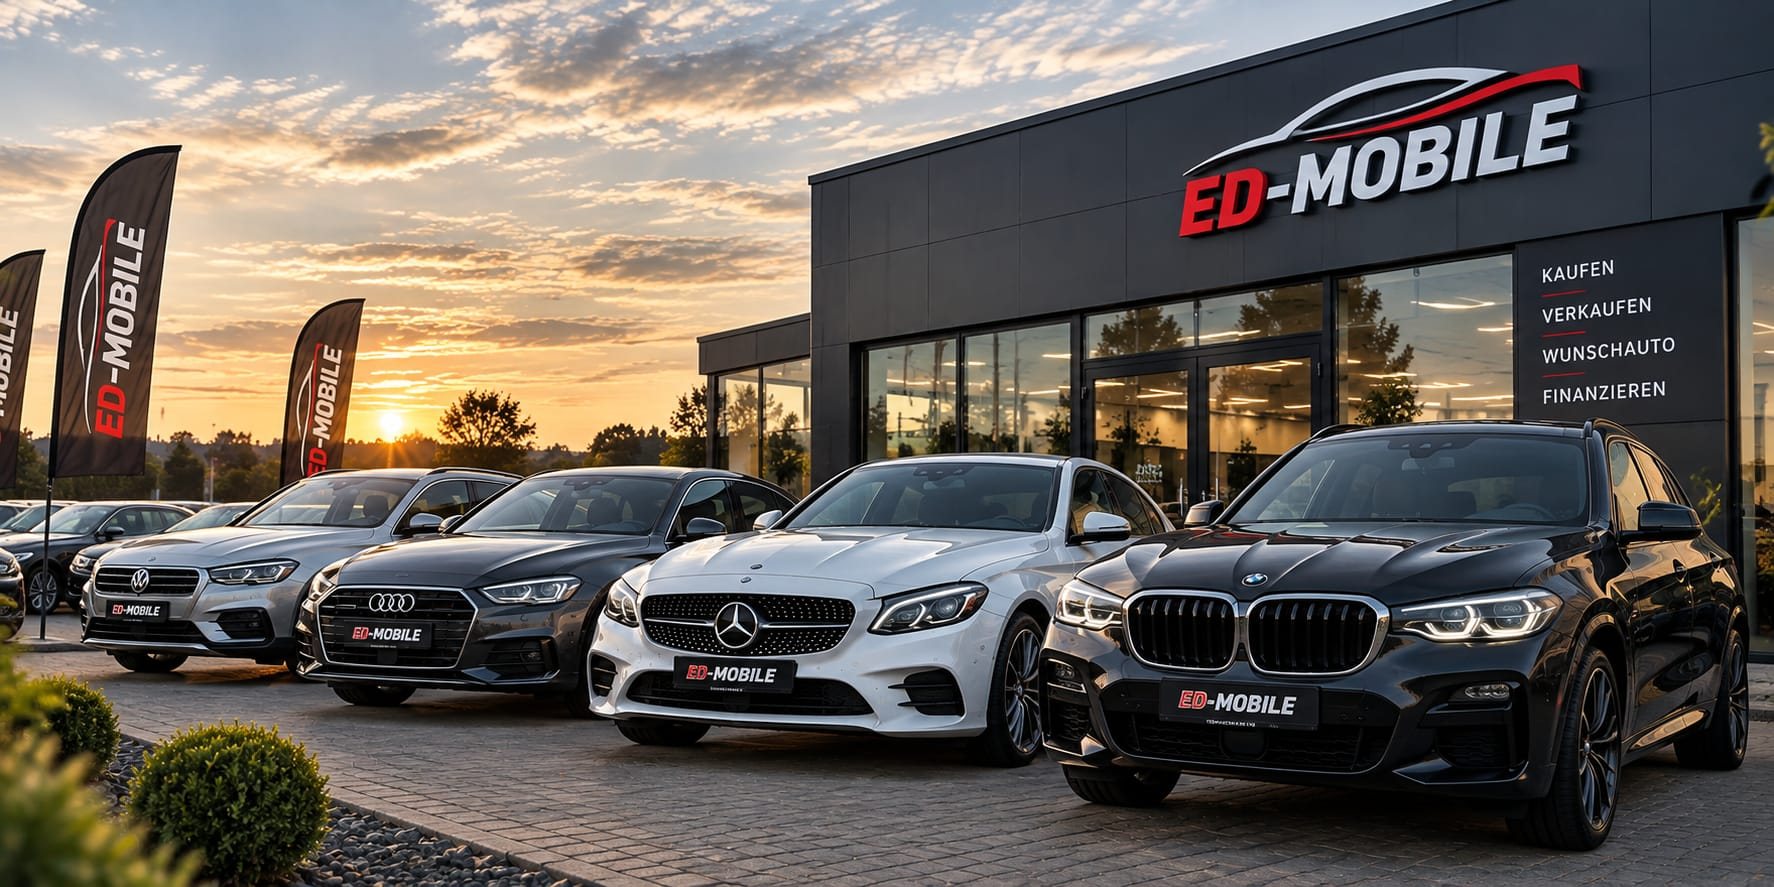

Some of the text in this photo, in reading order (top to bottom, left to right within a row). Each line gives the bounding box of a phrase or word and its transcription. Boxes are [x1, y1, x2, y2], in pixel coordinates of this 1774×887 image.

[1178, 94, 1578, 238] ED-MOBILE
[1542, 259, 1614, 284] KAUFEN
[1542, 296, 1652, 324] VERKAUFEN
[95, 221, 146, 439] ED-MOBILE
[1542, 336, 1676, 364] WUNSCHAUTO
[1542, 380, 1666, 405] FINANZIEREN
[112, 604, 161, 617] ED-MOBILE
[352, 626, 422, 642] ED-MOBILE
[686, 664, 777, 683] ED-MOBILE
[1178, 690, 1297, 716] ED-MOBILE
